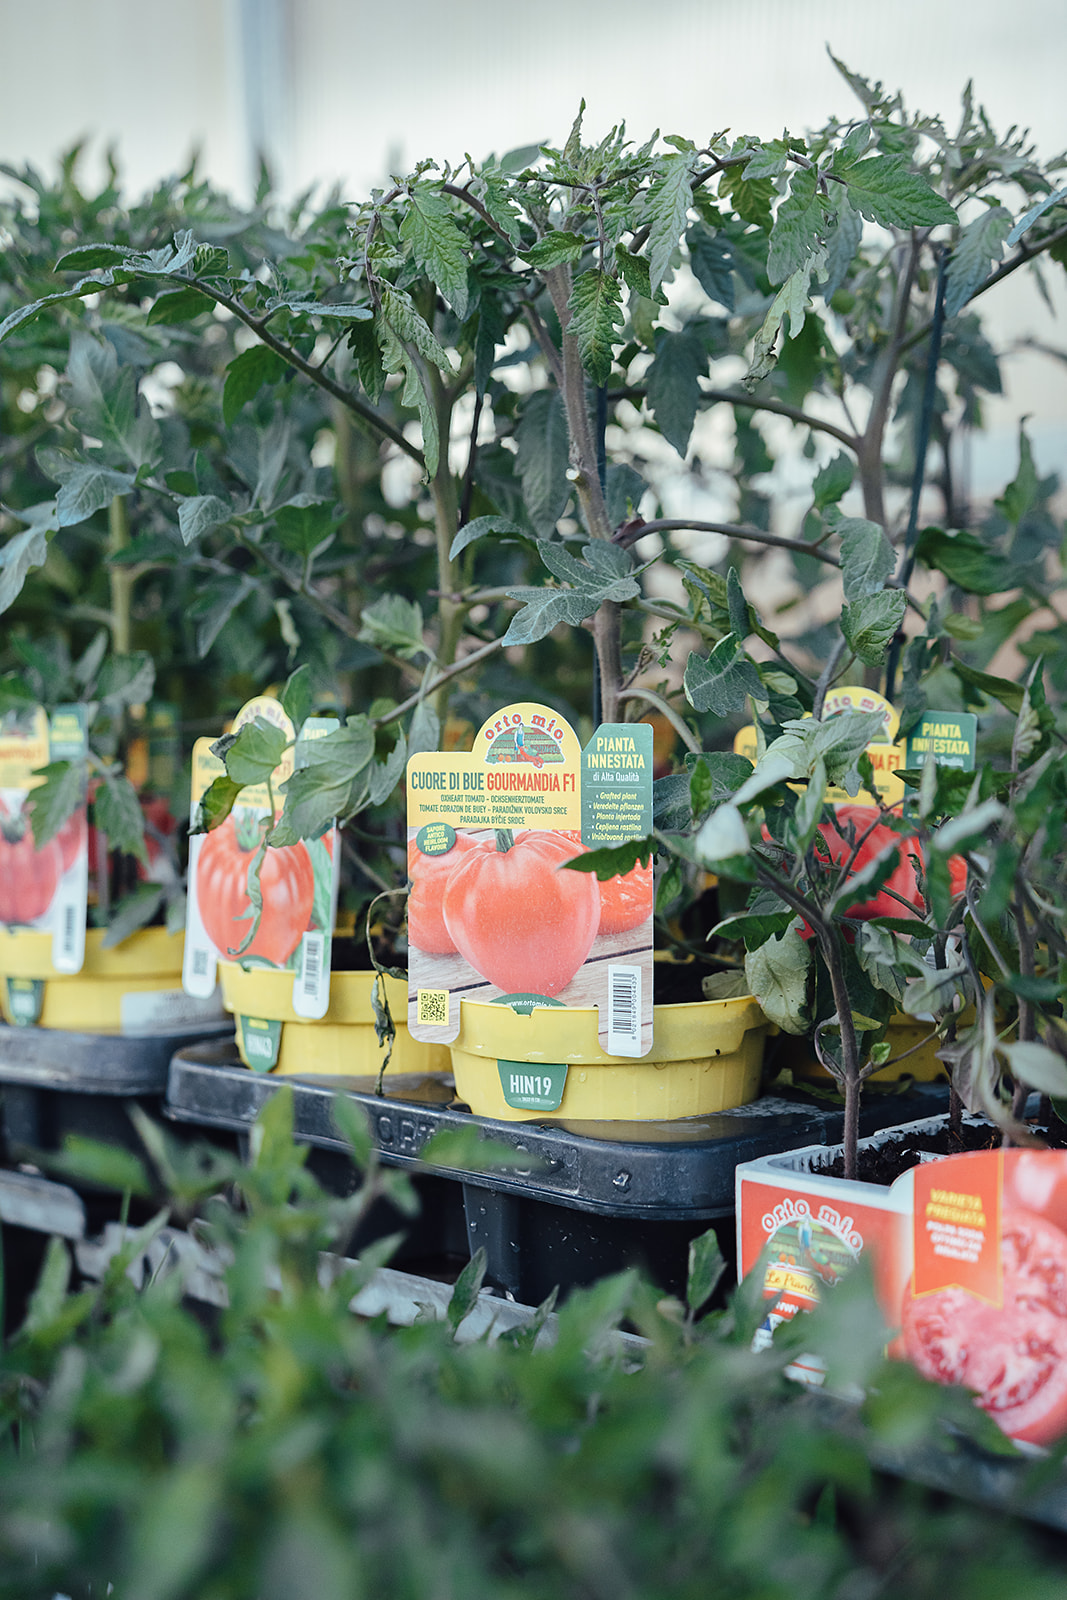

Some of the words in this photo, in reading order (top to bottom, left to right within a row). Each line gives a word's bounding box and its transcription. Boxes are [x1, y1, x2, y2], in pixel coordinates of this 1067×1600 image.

[485, 714, 521, 739] orto
[531, 714, 563, 739] mio
[922, 722, 962, 739] PIANTA
[596, 737, 636, 752] PIANTA
[587, 754, 645, 769] INNESTATA
[411, 771, 447, 790] CUORE
[449, 772, 460, 790] DI
[463, 772, 485, 790] BUE
[486, 772, 561, 792] GOURMANDIA
[563, 773, 575, 792] F1
[592, 771, 599, 782] di
[601, 771, 614, 782] Alta
[615, 771, 640, 782] Qualità
[440, 794, 463, 803] OXHEART
[465, 795, 485, 803] TOMATO
[491, 795, 545, 804] OCHSENHERZTOMATE
[599, 791, 621, 800] Grafted
[621, 792, 637, 801] plant
[419, 804, 438, 813] TOMATE
[465, 805, 472, 813] DE
[473, 805, 486, 814] BUEY
[524, 806, 552, 815] VOLOVSKO
[553, 806, 568, 815] SRCE
[593, 802, 619, 811] Veredelte
[619, 802, 645, 812] pflanzen
[459, 815, 490, 824] PARADAJKA
[508, 816, 525, 825] SRDCE
[595, 812, 614, 821] Planta
[510, 1074, 552, 1096] HIN19
[762, 1198, 810, 1233] orto
[818, 1205, 863, 1253] mio
